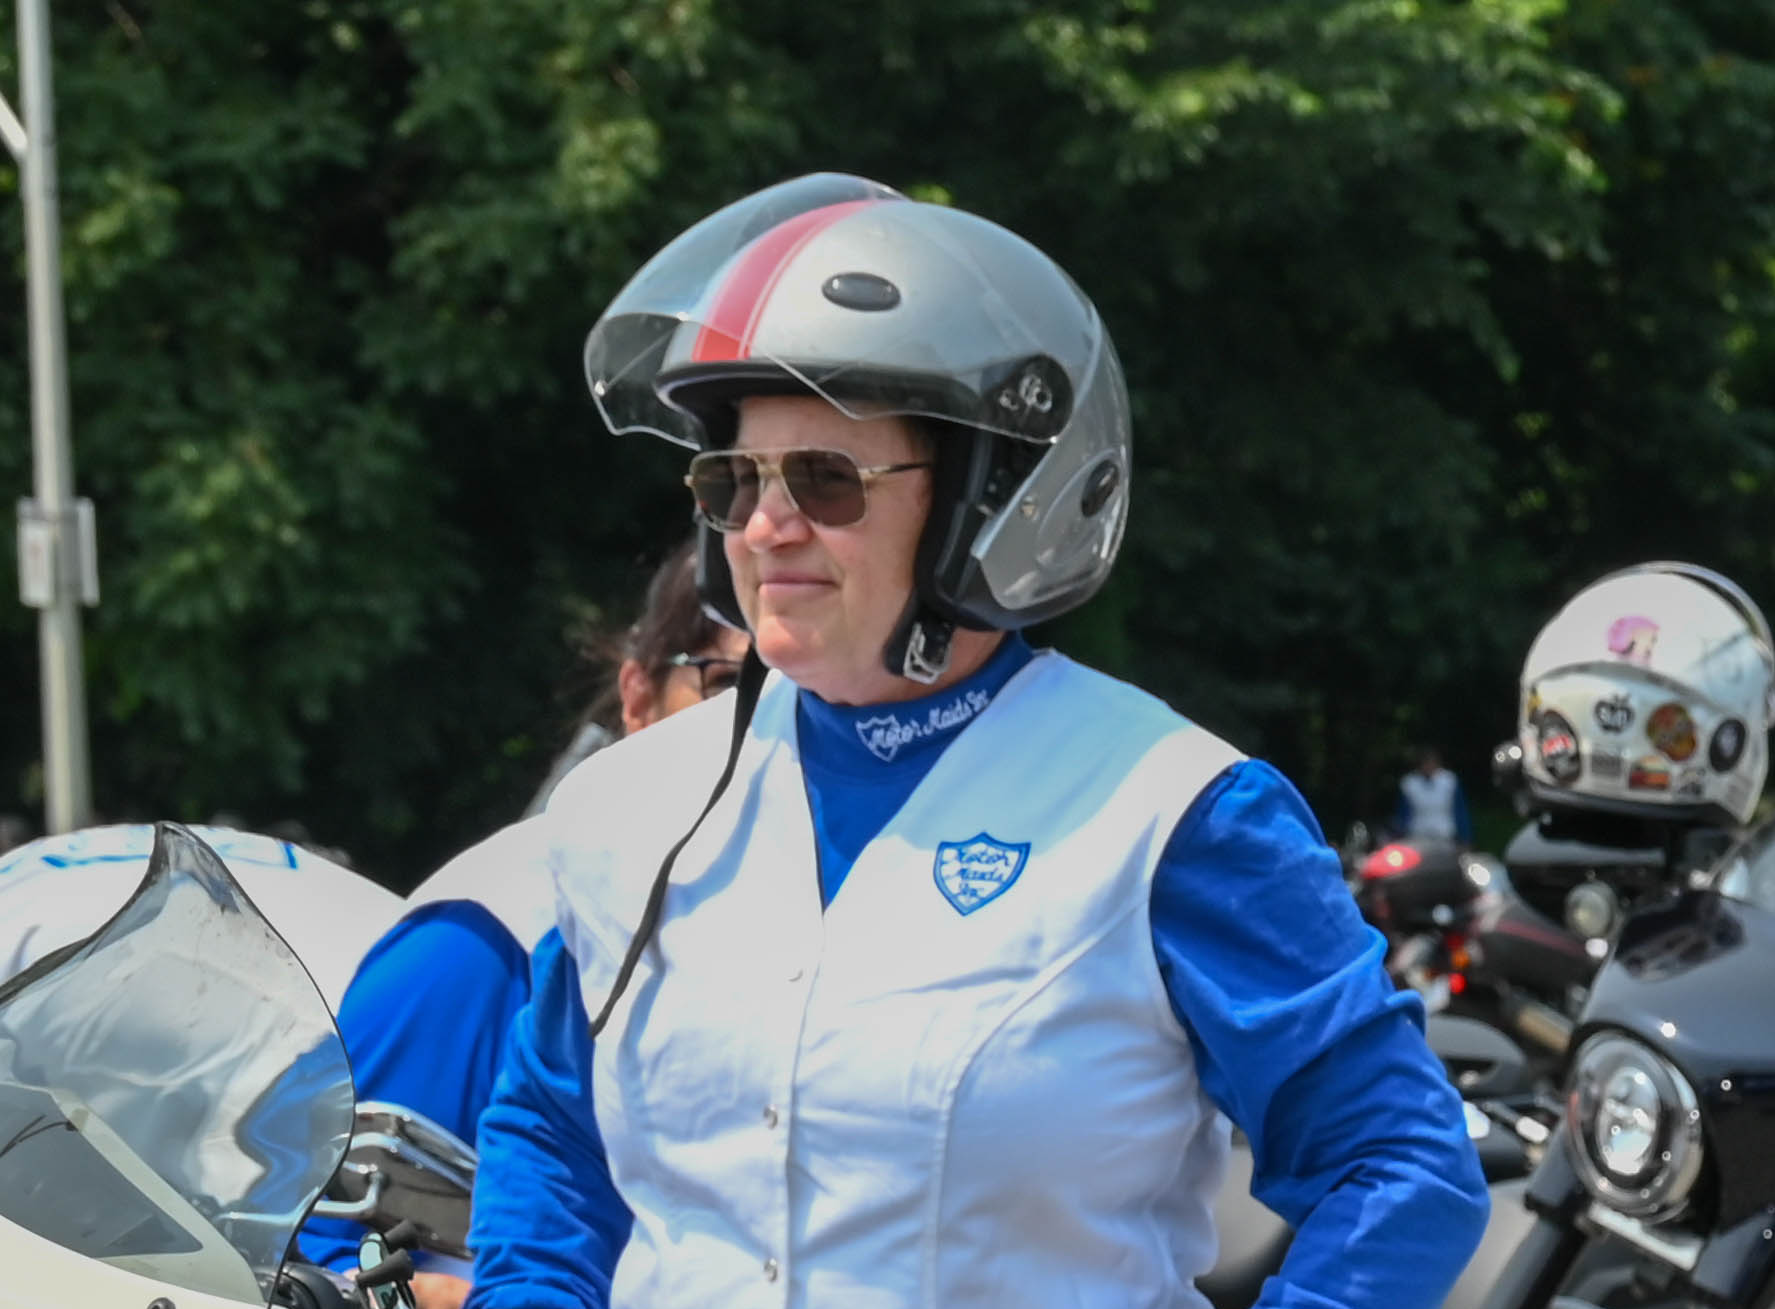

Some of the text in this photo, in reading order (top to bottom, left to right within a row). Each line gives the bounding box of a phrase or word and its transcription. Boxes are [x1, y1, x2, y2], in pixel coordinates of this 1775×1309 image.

[871, 716, 923, 749] Motor
[923, 697, 973, 736] Maids
[941, 848, 1009, 867] Motor
